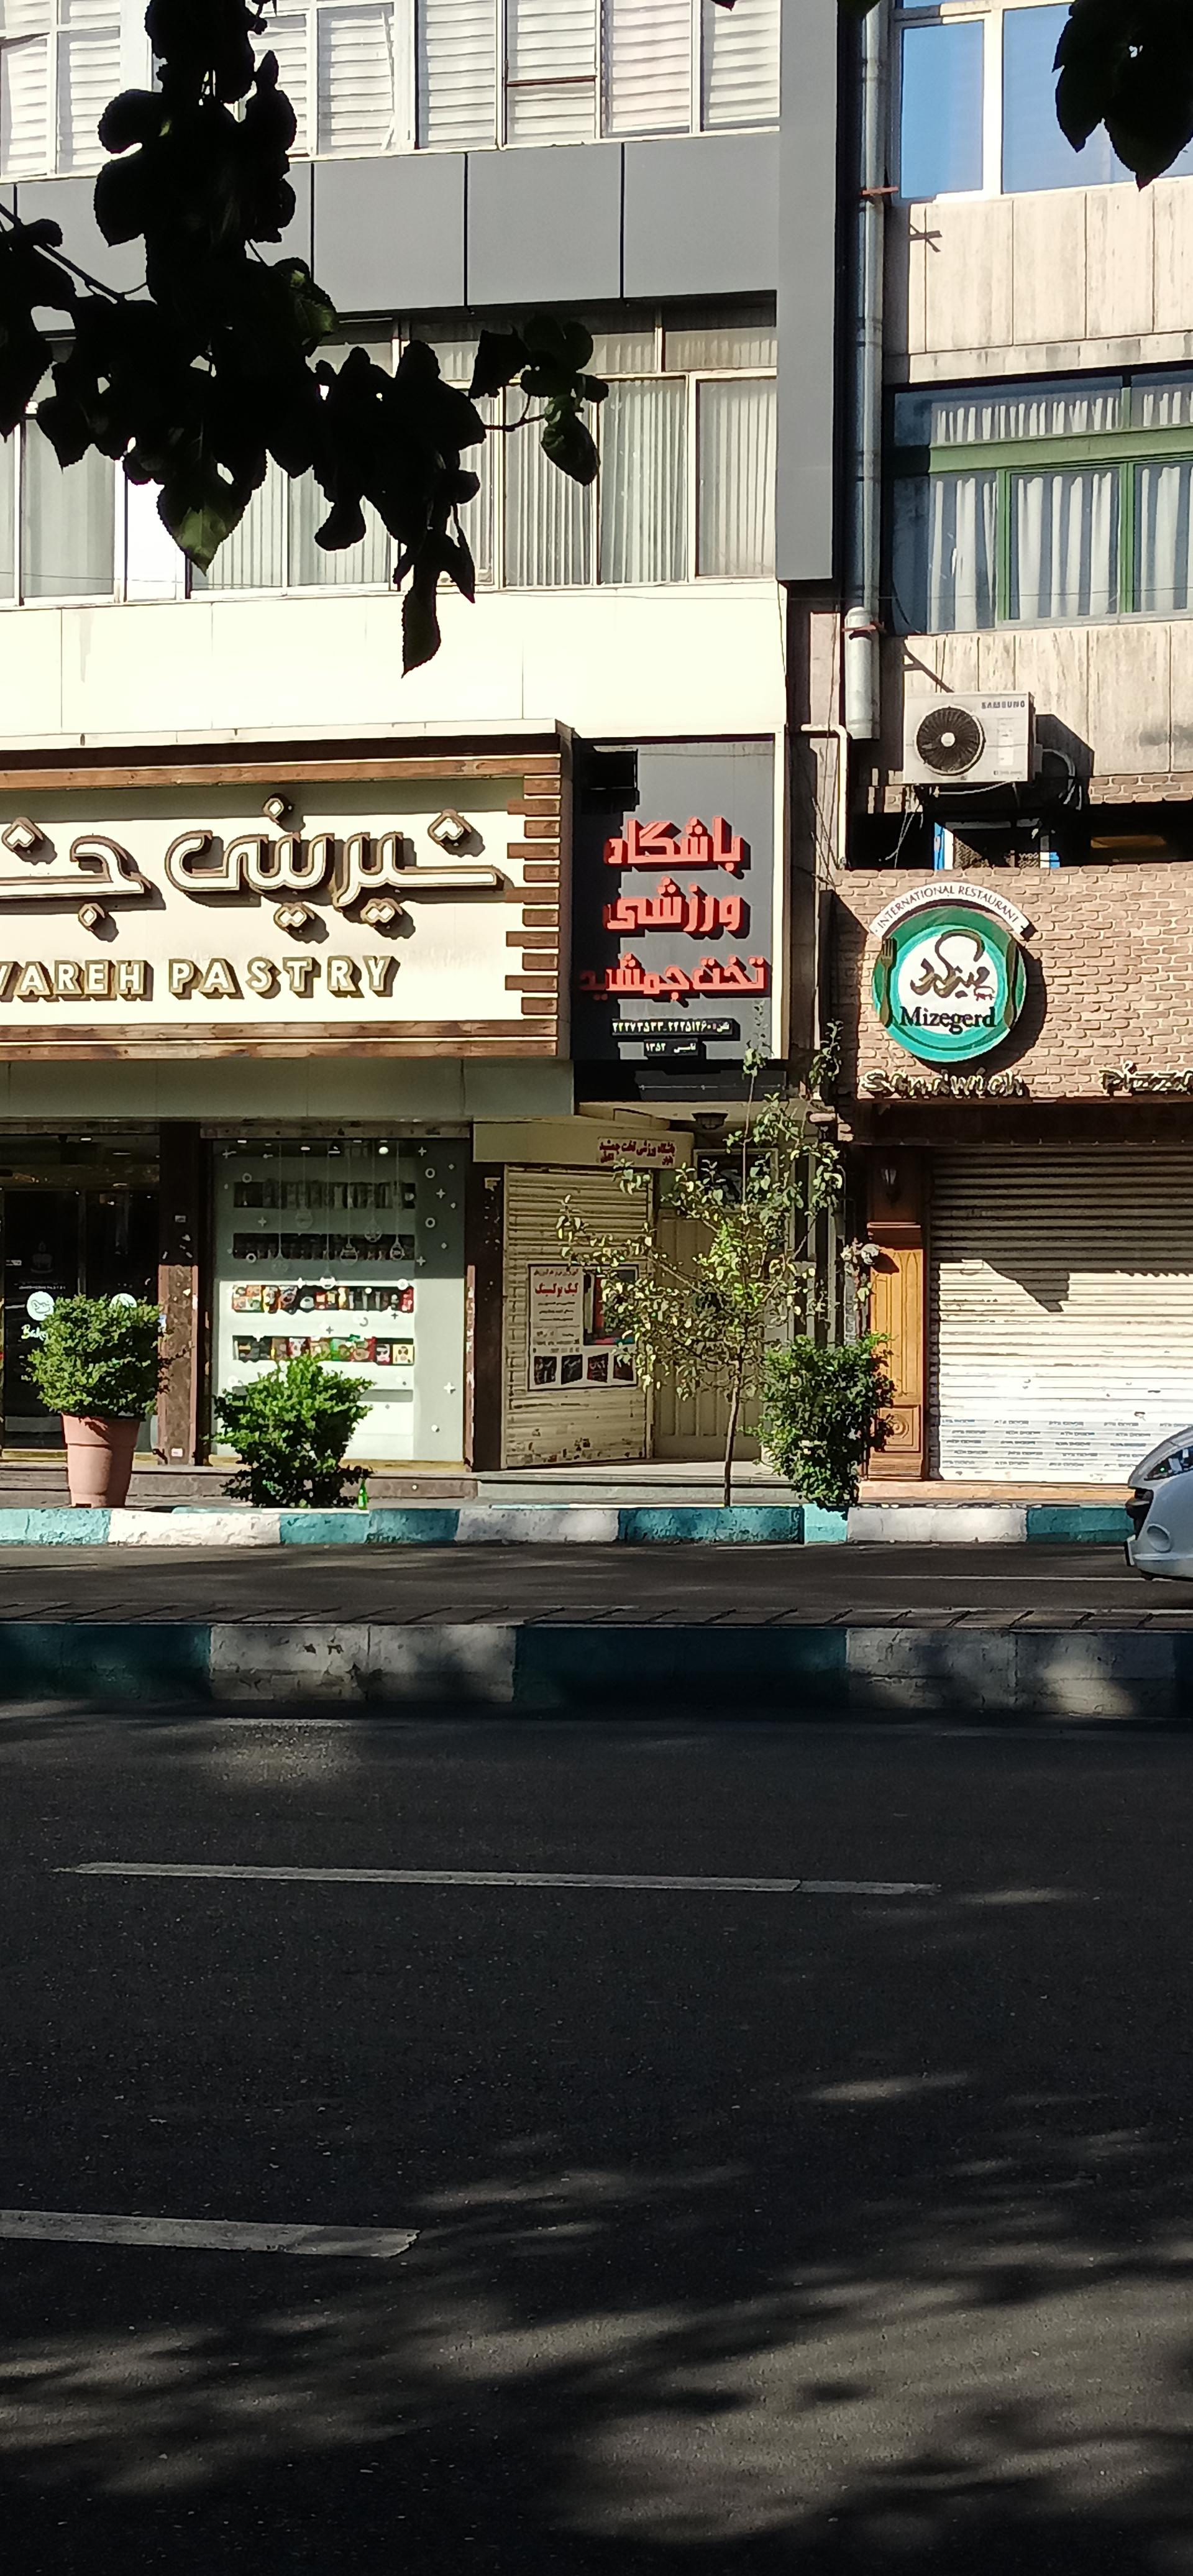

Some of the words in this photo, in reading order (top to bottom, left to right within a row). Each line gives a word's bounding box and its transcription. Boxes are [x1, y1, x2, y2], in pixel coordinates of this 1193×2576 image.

[165, 795, 503, 927] شیرینی
[605, 816, 744, 871] باشگاه
[603, 876, 742, 932] ورزشی
[877, 885, 955, 929] INTERNATIONAL
[958, 886, 1019, 924] RESTAURANT
[169, 956, 398, 999] PASTRY
[579, 951, 690, 1002] جمشید
[692, 955, 764, 990] تخت
[900, 1006, 997, 1035] Mizegerd
[861, 1067, 1024, 1096] Sandwich
